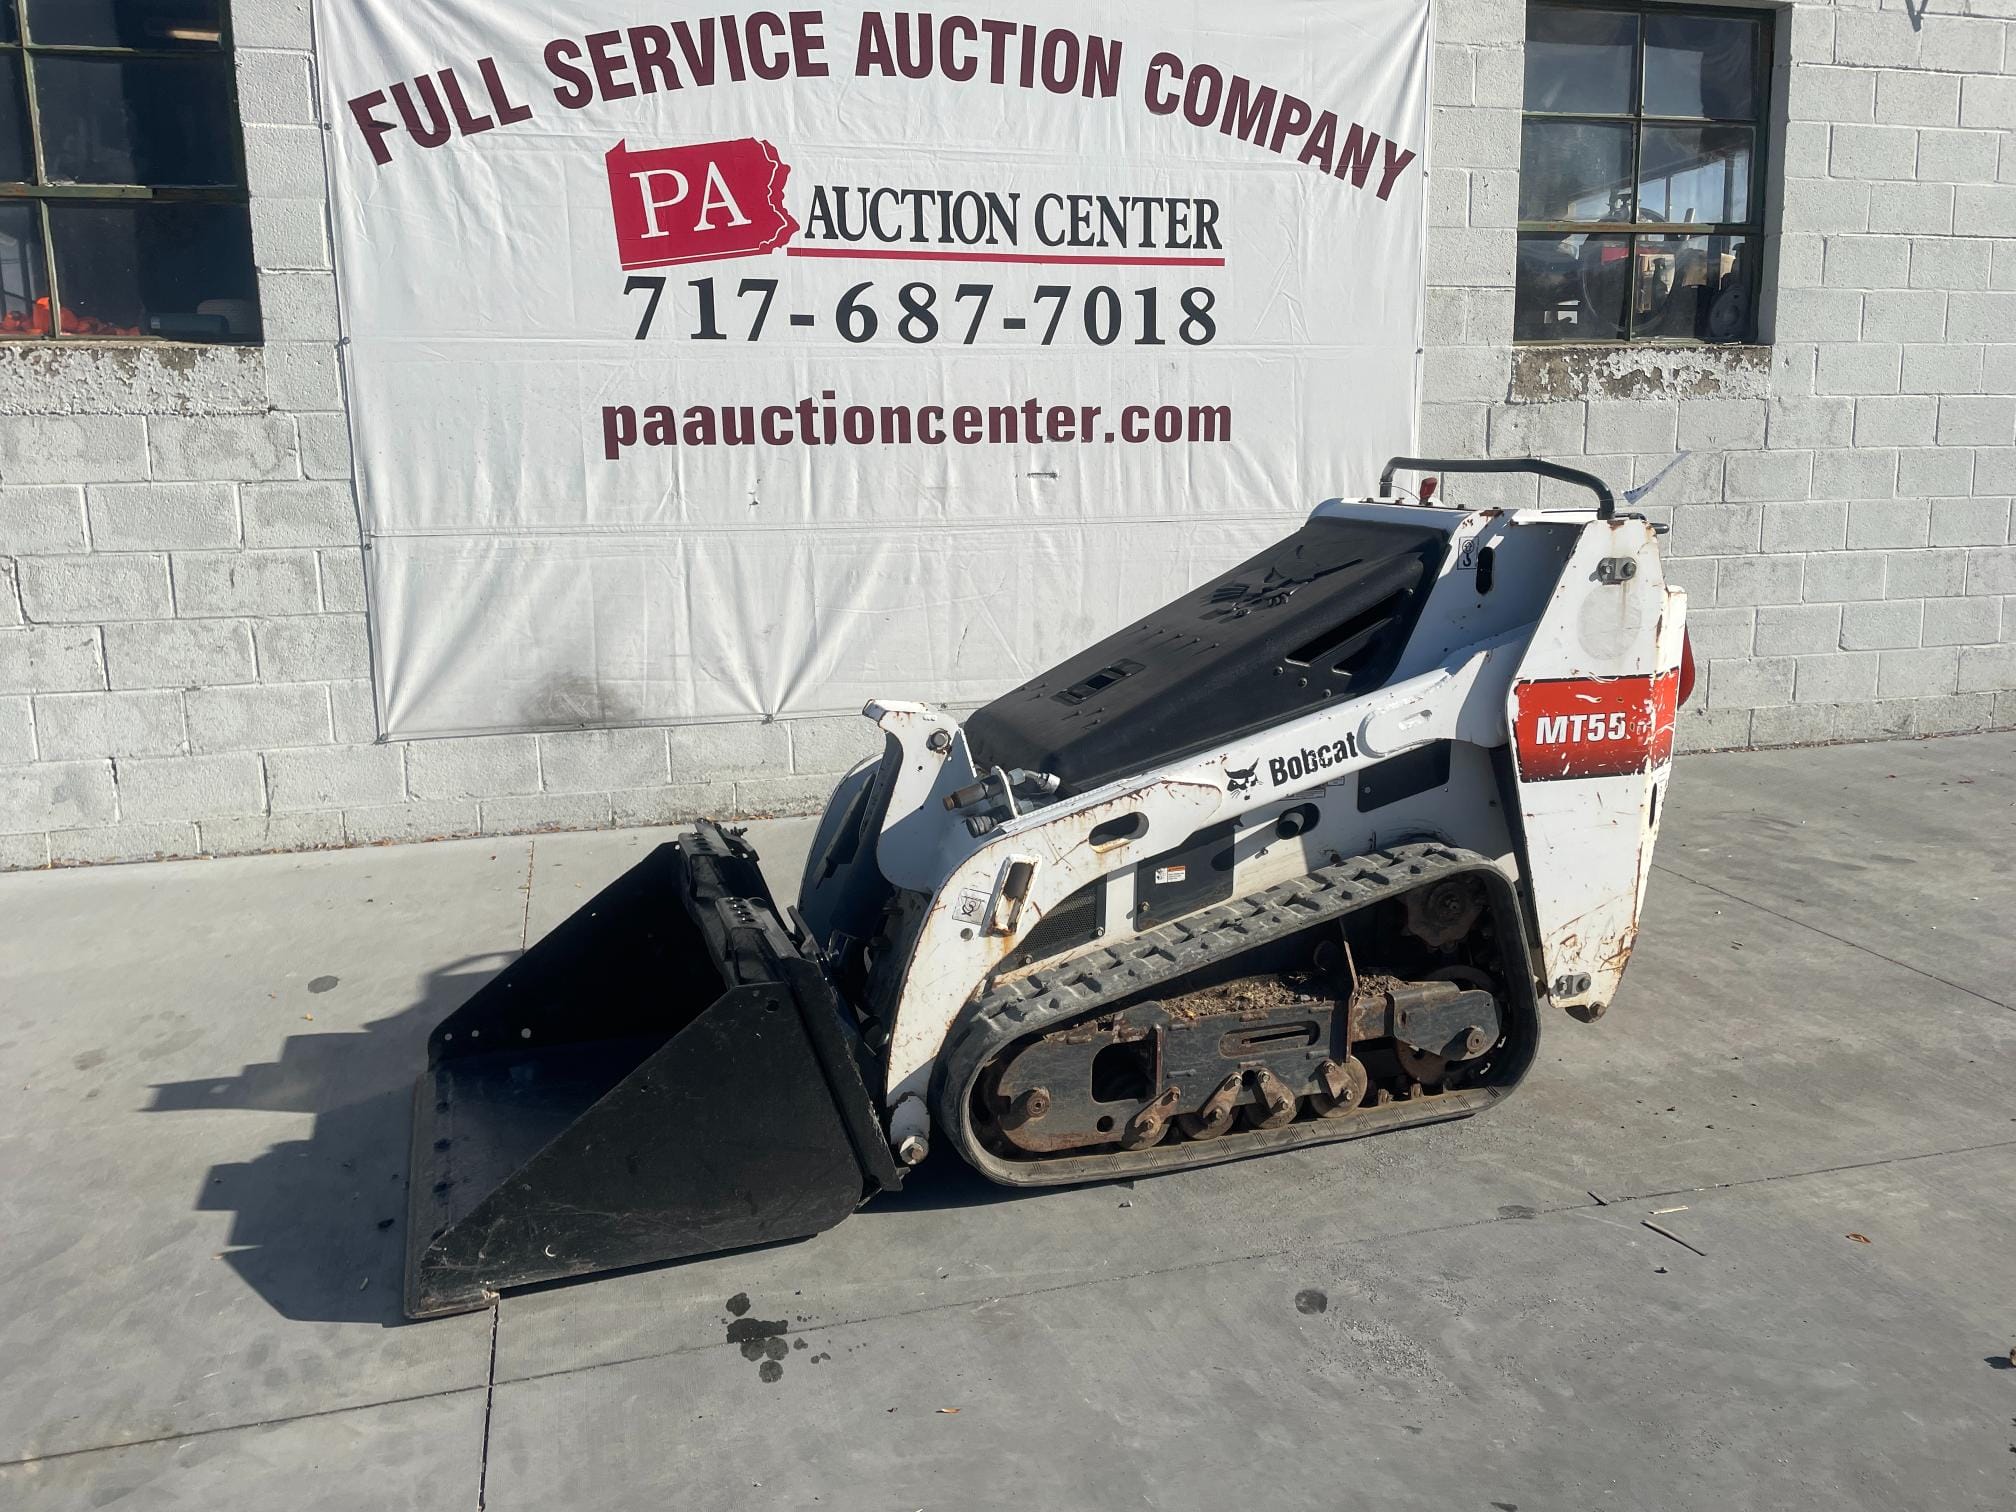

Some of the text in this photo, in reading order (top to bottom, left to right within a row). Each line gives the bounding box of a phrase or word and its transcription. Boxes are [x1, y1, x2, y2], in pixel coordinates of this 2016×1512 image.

[347, 10, 1417, 202] FULL SERVICE AUCTION COMPANY
[629, 161, 1223, 250] PA AUCTION CENTER
[623, 275, 1217, 347] 717-687-7018
[602, 390, 1232, 460] paauctioncenter.com
[1268, 731, 1359, 787] Bobcat
